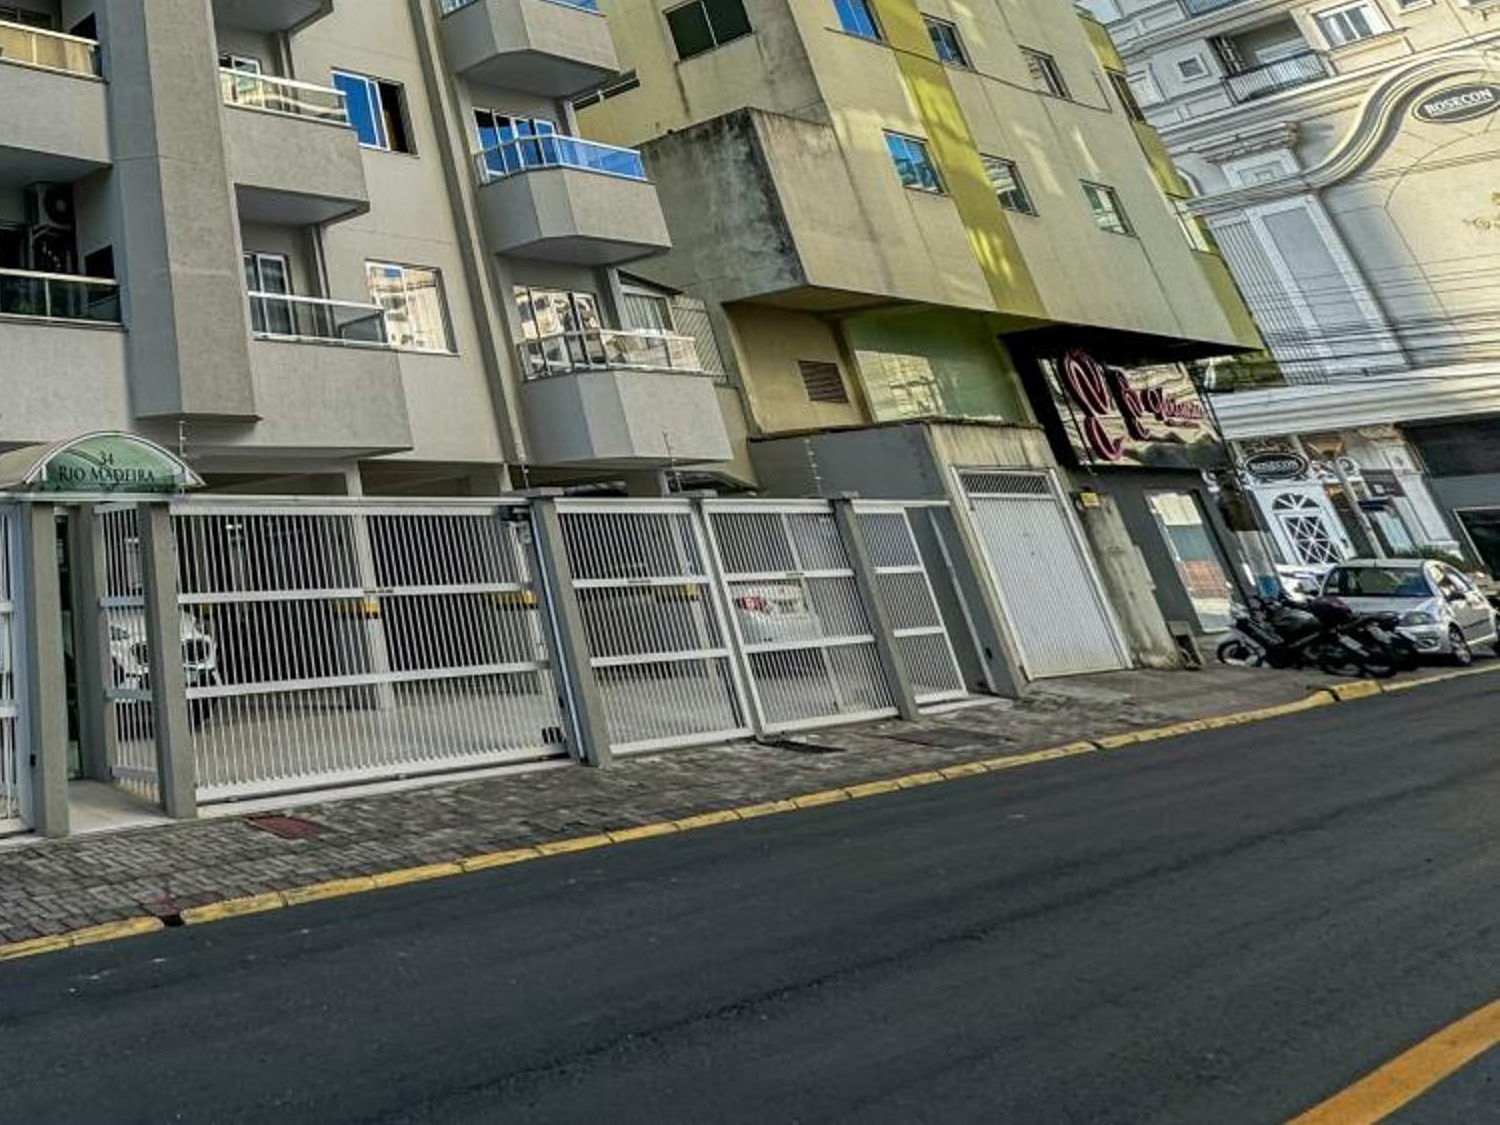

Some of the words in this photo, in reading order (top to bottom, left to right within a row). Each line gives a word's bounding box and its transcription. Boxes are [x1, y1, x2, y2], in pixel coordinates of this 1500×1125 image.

[1423, 88, 1495, 116] ROSECON
[59, 465, 86, 482] RIO
[91, 466, 155, 483] MADEIRA
